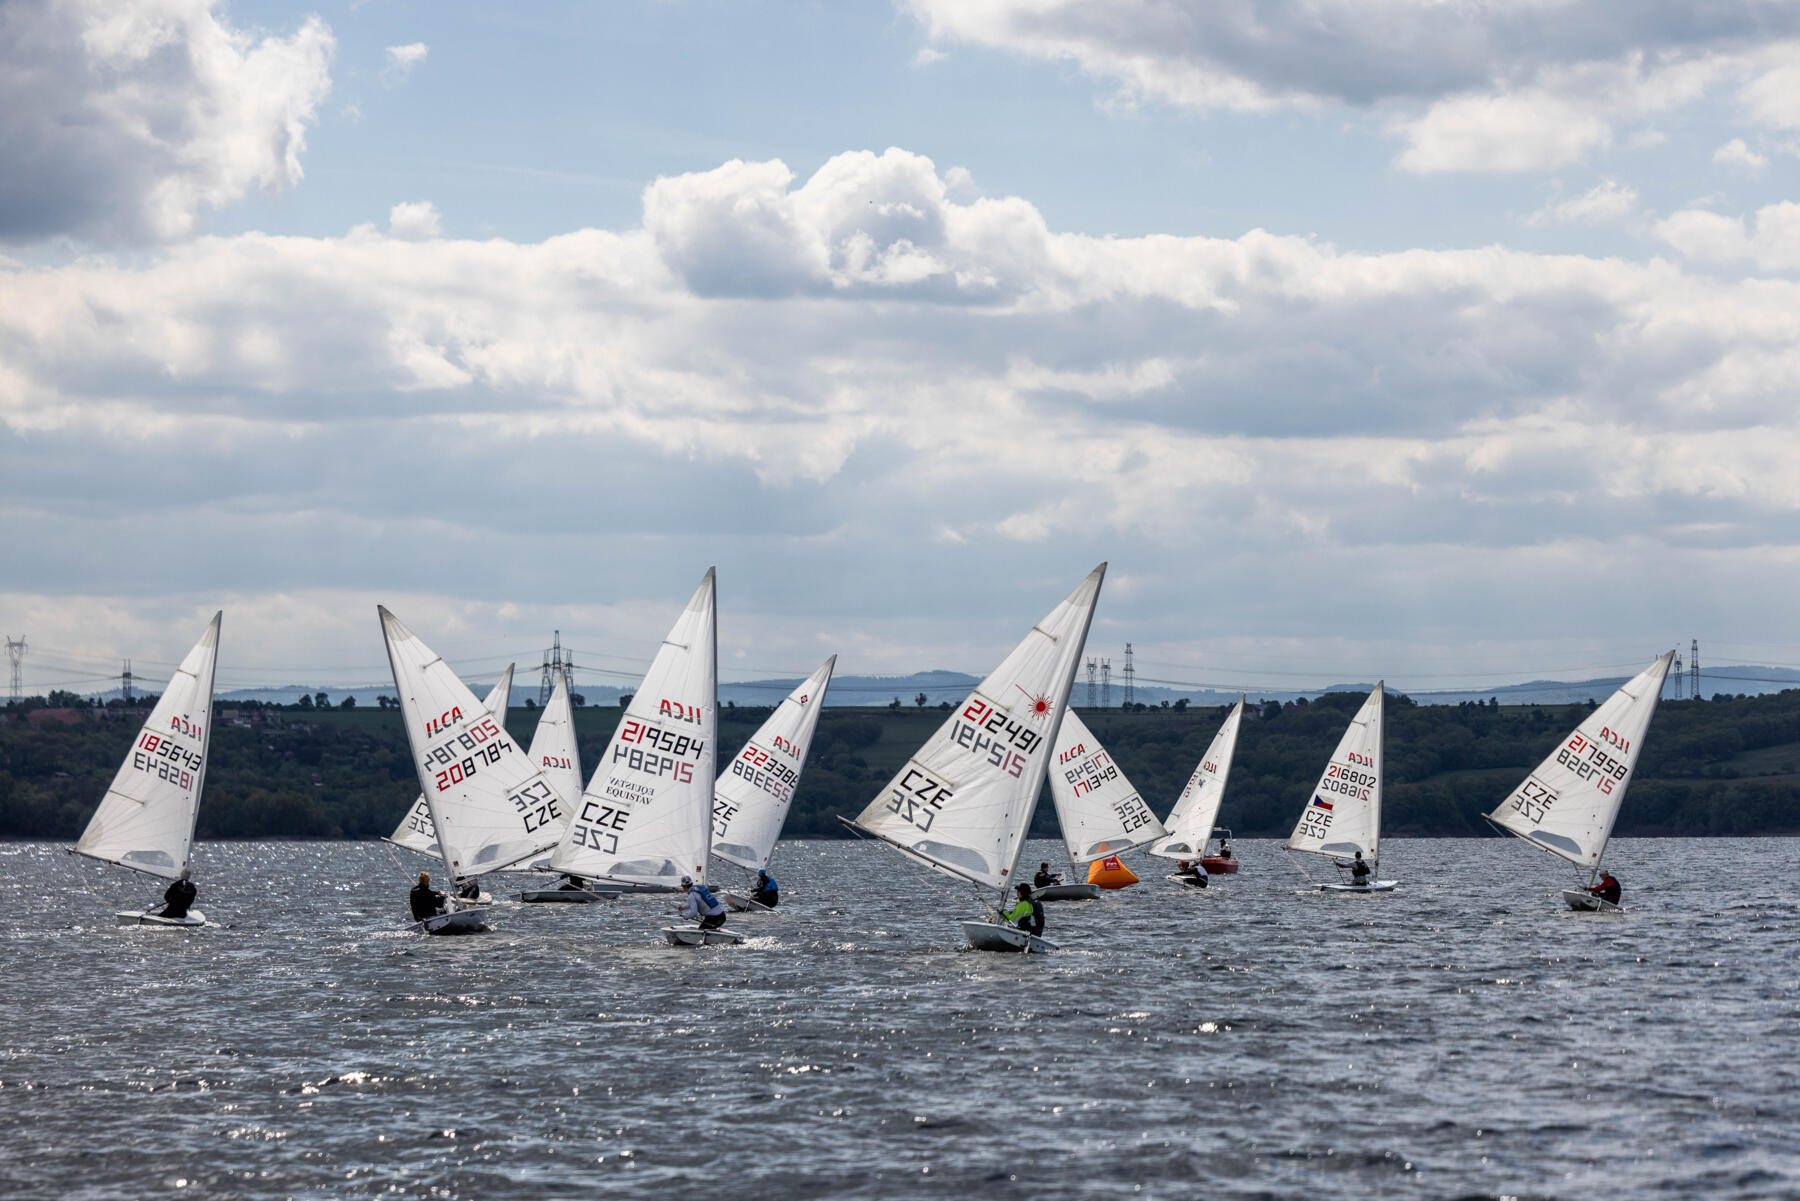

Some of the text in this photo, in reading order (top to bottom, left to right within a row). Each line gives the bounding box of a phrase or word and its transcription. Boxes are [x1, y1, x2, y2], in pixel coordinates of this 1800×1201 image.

[426, 706, 464, 738] ILCA
[963, 699, 1042, 754] 212491
[139, 733, 202, 771] 185643
[621, 721, 704, 760] 219584
[1060, 744, 1086, 765] ILCA
[436, 739, 512, 791] 208784
[1568, 735, 1628, 780] 217958
[900, 769, 953, 810] CZE
[1074, 766, 1118, 798] 171349
[1328, 765, 1377, 789] 216802
[713, 798, 738, 821] ZE
[1522, 781, 1558, 810] CZE
[523, 799, 562, 833] CZE
[581, 802, 630, 831] CZE
[1123, 810, 1151, 833] CZE
[1306, 810, 1333, 828] CZE
